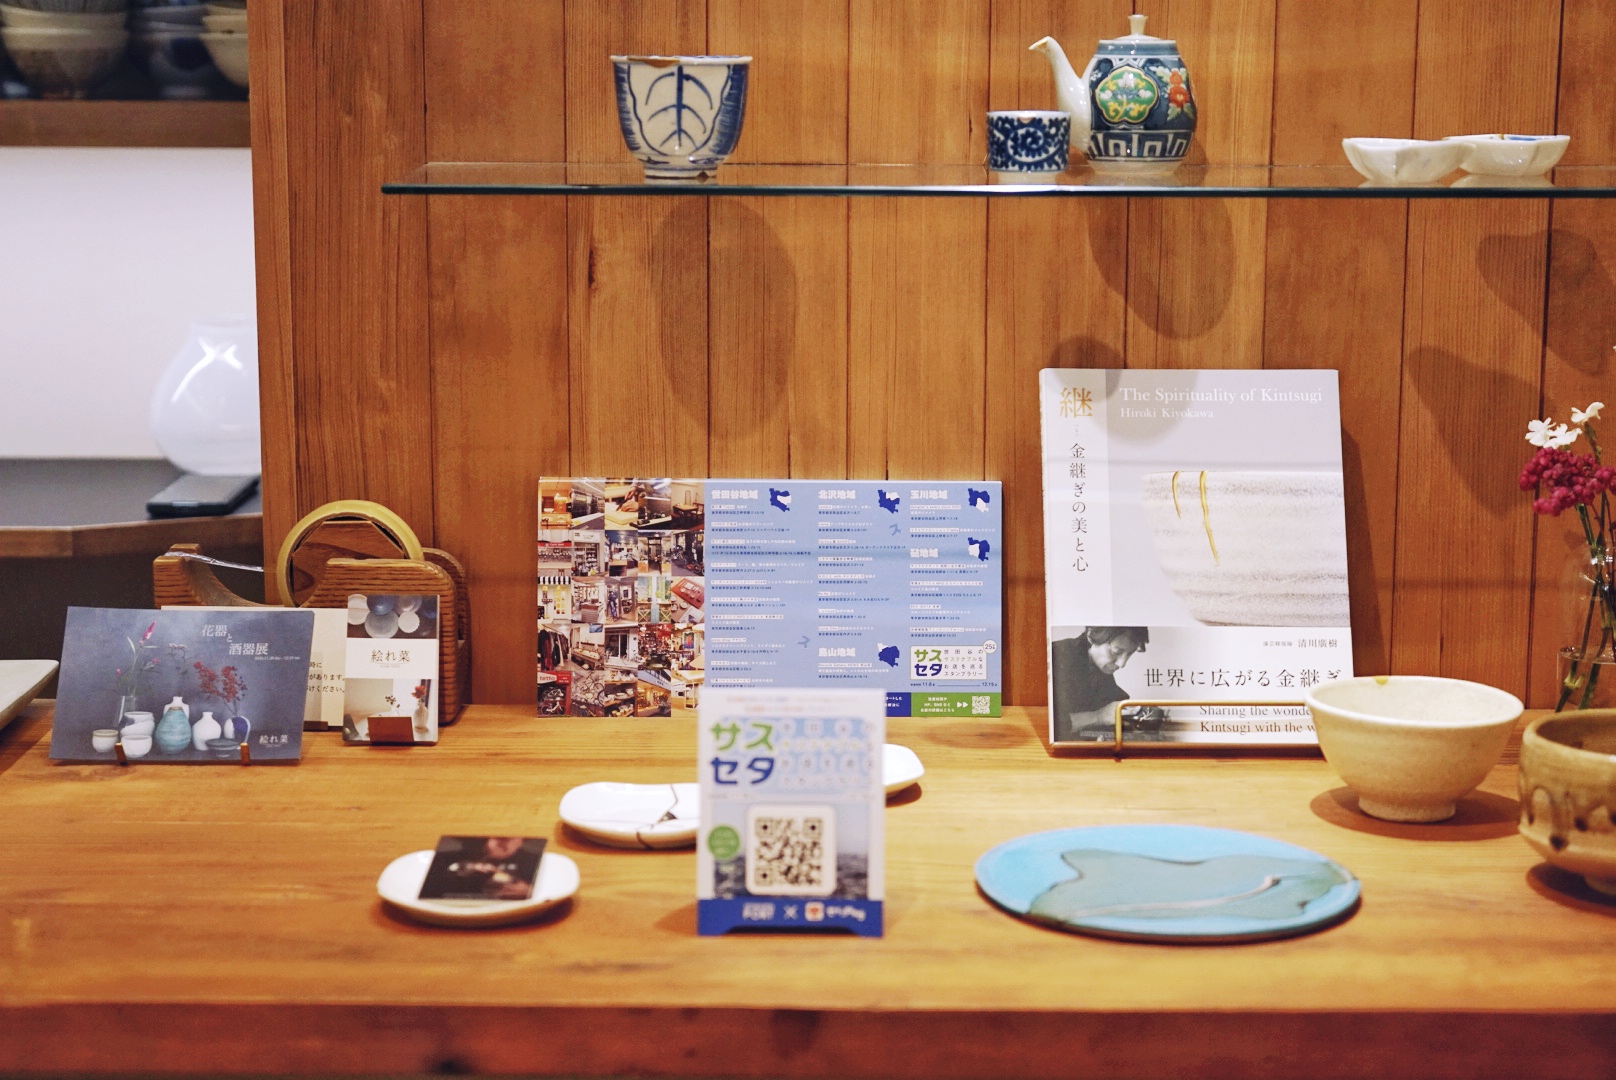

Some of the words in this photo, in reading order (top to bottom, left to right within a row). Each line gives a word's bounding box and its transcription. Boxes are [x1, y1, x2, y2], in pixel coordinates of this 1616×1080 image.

[1119, 387, 1151, 402] The
[1155, 387, 1236, 404] Spirituality
[1240, 387, 1257, 402] of
[1260, 387, 1323, 404] Kintsugi
[1059, 387, 1094, 419] 継
[1120, 407, 1157, 419] Hiroki
[1162, 407, 1215, 421] Kiyokawa
[1069, 442, 1090, 573] 金継ぎの美と心
[202, 624, 228, 637] 花器
[226, 633, 233, 643] と
[229, 642, 269, 655] 酒器展
[371, 649, 411, 663] 絵れ菜
[914, 649, 942, 663] サス
[914, 663, 943, 677] セタ
[306, 685, 345, 693] けください。
[1199, 705, 1247, 718] Sharing
[1250, 706, 1269, 716] the
[1200, 721, 1251, 736] Kintsugi
[1255, 721, 1281, 733] with
[1285, 722, 1303, 733] the
[710, 721, 774, 751] サス
[710, 757, 775, 785] セタ
